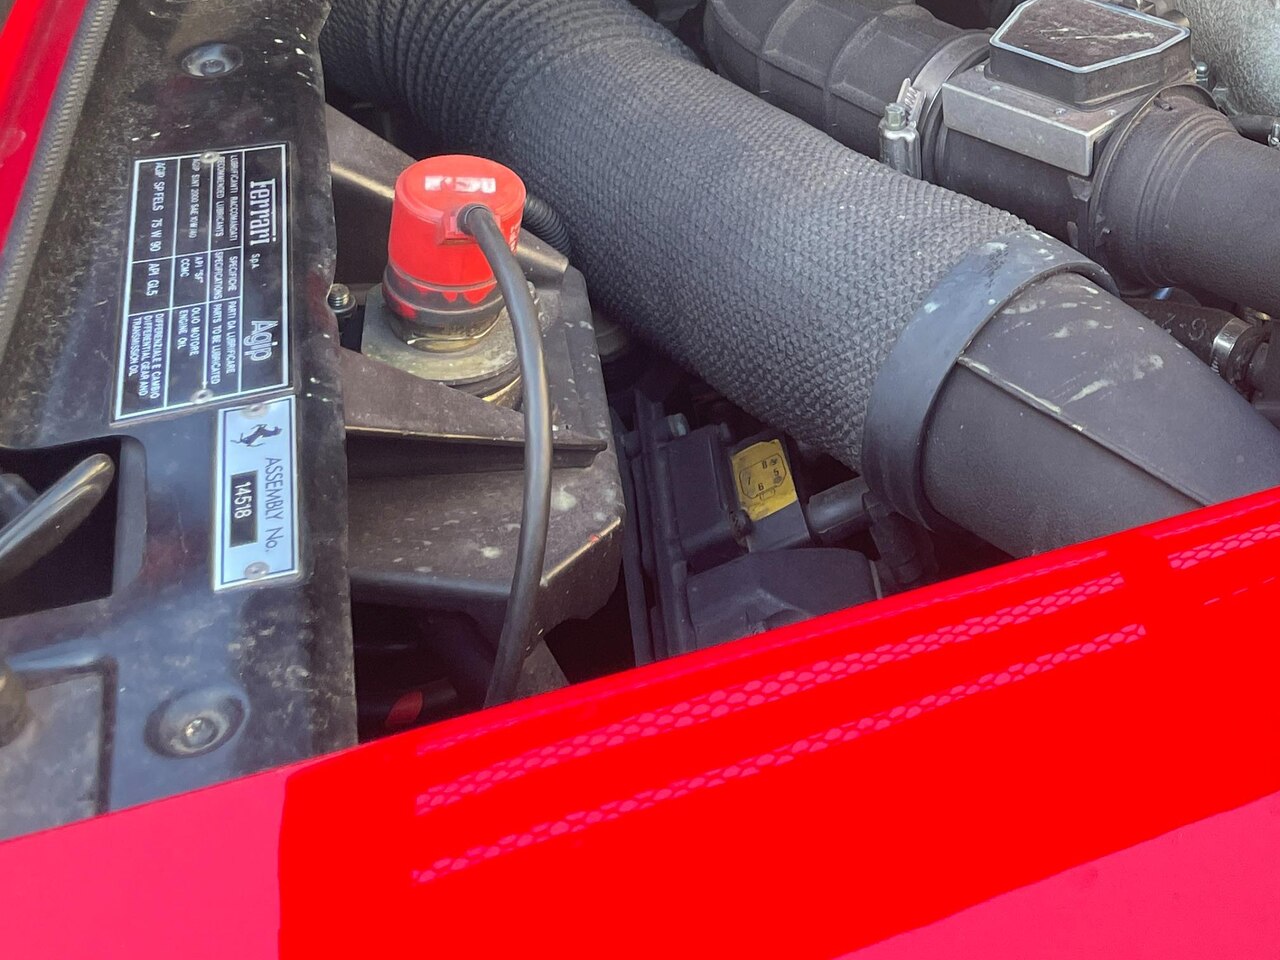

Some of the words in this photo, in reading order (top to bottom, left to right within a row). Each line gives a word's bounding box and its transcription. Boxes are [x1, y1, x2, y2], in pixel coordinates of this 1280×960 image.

[155, 162, 164, 178] AGIP
[192, 159, 200, 172] AGIP
[229, 155, 238, 193] LUBRIFICANTI
[191, 189, 199, 202] 2000
[190, 204, 198, 214] SAE
[249, 179, 277, 246] Ferrari
[152, 218, 163, 228] 75
[215, 201, 224, 237] LUBRICANTS
[229, 196, 238, 241] RACCOMANDATI
[151, 230, 162, 238] W
[150, 241, 161, 251] 90
[148, 264, 158, 276] API
[180, 259, 189, 277] CCMC
[195, 257, 203, 267] API
[213, 252, 223, 299] SPECIFICATIONS
[228, 256, 238, 291] SPECIFICHE
[146, 280, 157, 296] GL5
[191, 308, 200, 324] OLIO
[213, 304, 221, 322] PARTS
[228, 301, 236, 318] PARTI
[178, 310, 188, 334] ENGINE
[227, 320, 236, 330] DA
[130, 318, 141, 364] TRANSMISSION
[141, 316, 152, 361] DIFFERENTIAL
[153, 313, 164, 362] DIFFERENZIALE
[178, 338, 187, 349] OIL
[190, 327, 200, 356] MOTORE
[212, 333, 220, 344] BE
[244, 320, 278, 361] Agip
[226, 332, 236, 373] LUBRIFICARE
[129, 365, 138, 376] OIL
[140, 362, 150, 379] GEAR
[211, 345, 220, 384] LUBRICATED
[139, 380, 148, 395] AND
[151, 371, 161, 398] CAMBIO
[264, 456, 284, 521] ASSEMBLY
[233, 481, 252, 520] 14518
[265, 527, 284, 553] No.
